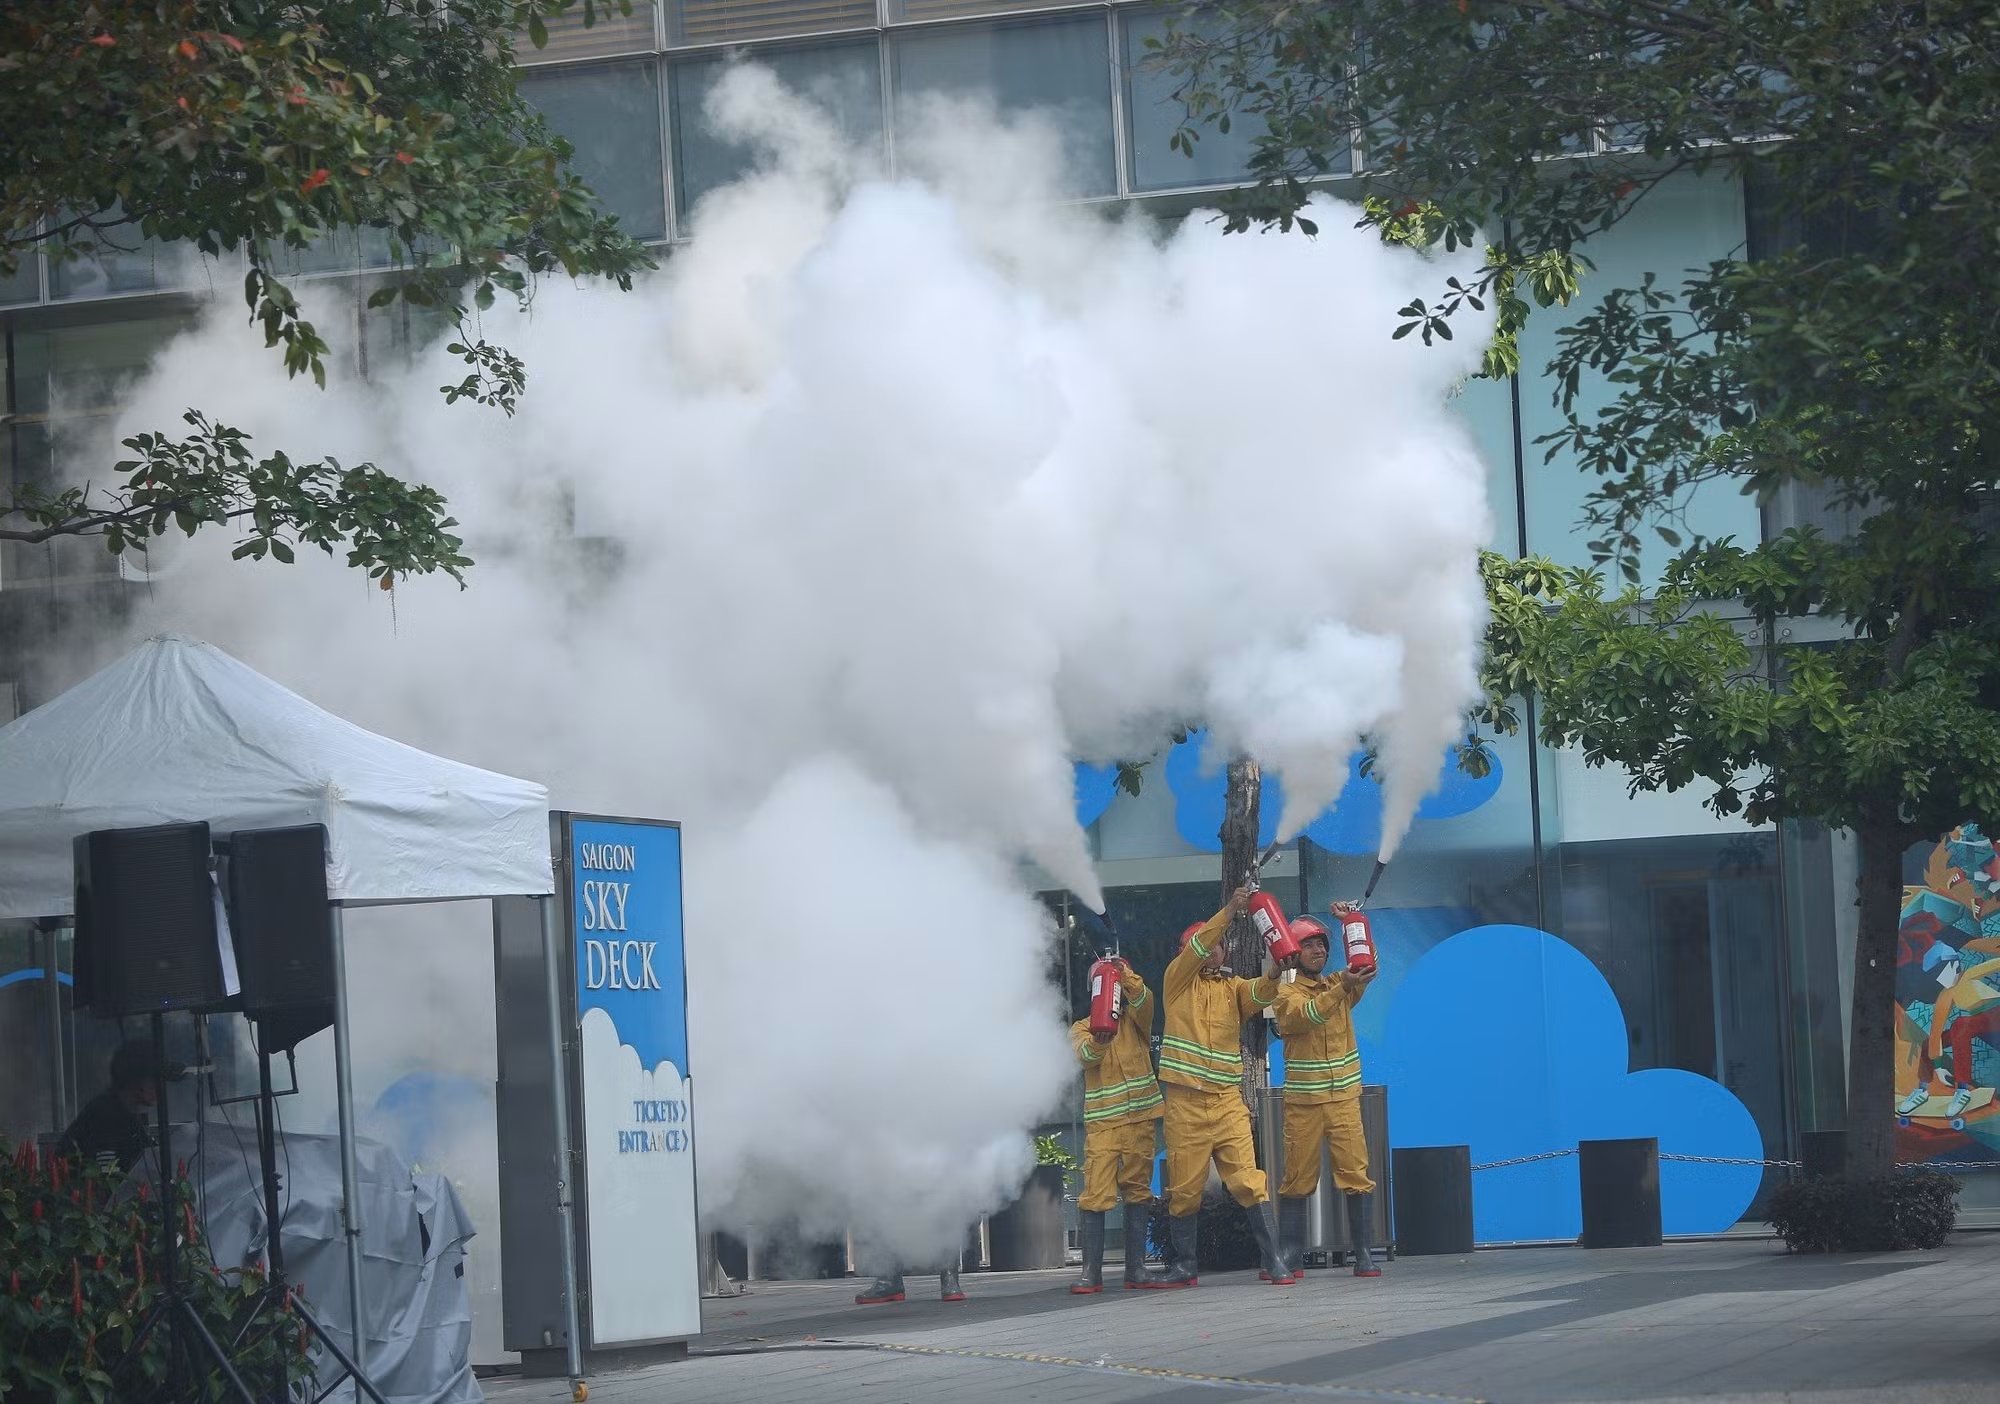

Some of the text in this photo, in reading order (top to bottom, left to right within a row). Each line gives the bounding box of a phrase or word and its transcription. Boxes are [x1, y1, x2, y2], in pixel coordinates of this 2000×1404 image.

[582, 843, 635, 870] SAIGON
[584, 880, 630, 931] SKY
[584, 940, 661, 989] DECK
[633, 1100, 679, 1122] TICKETS
